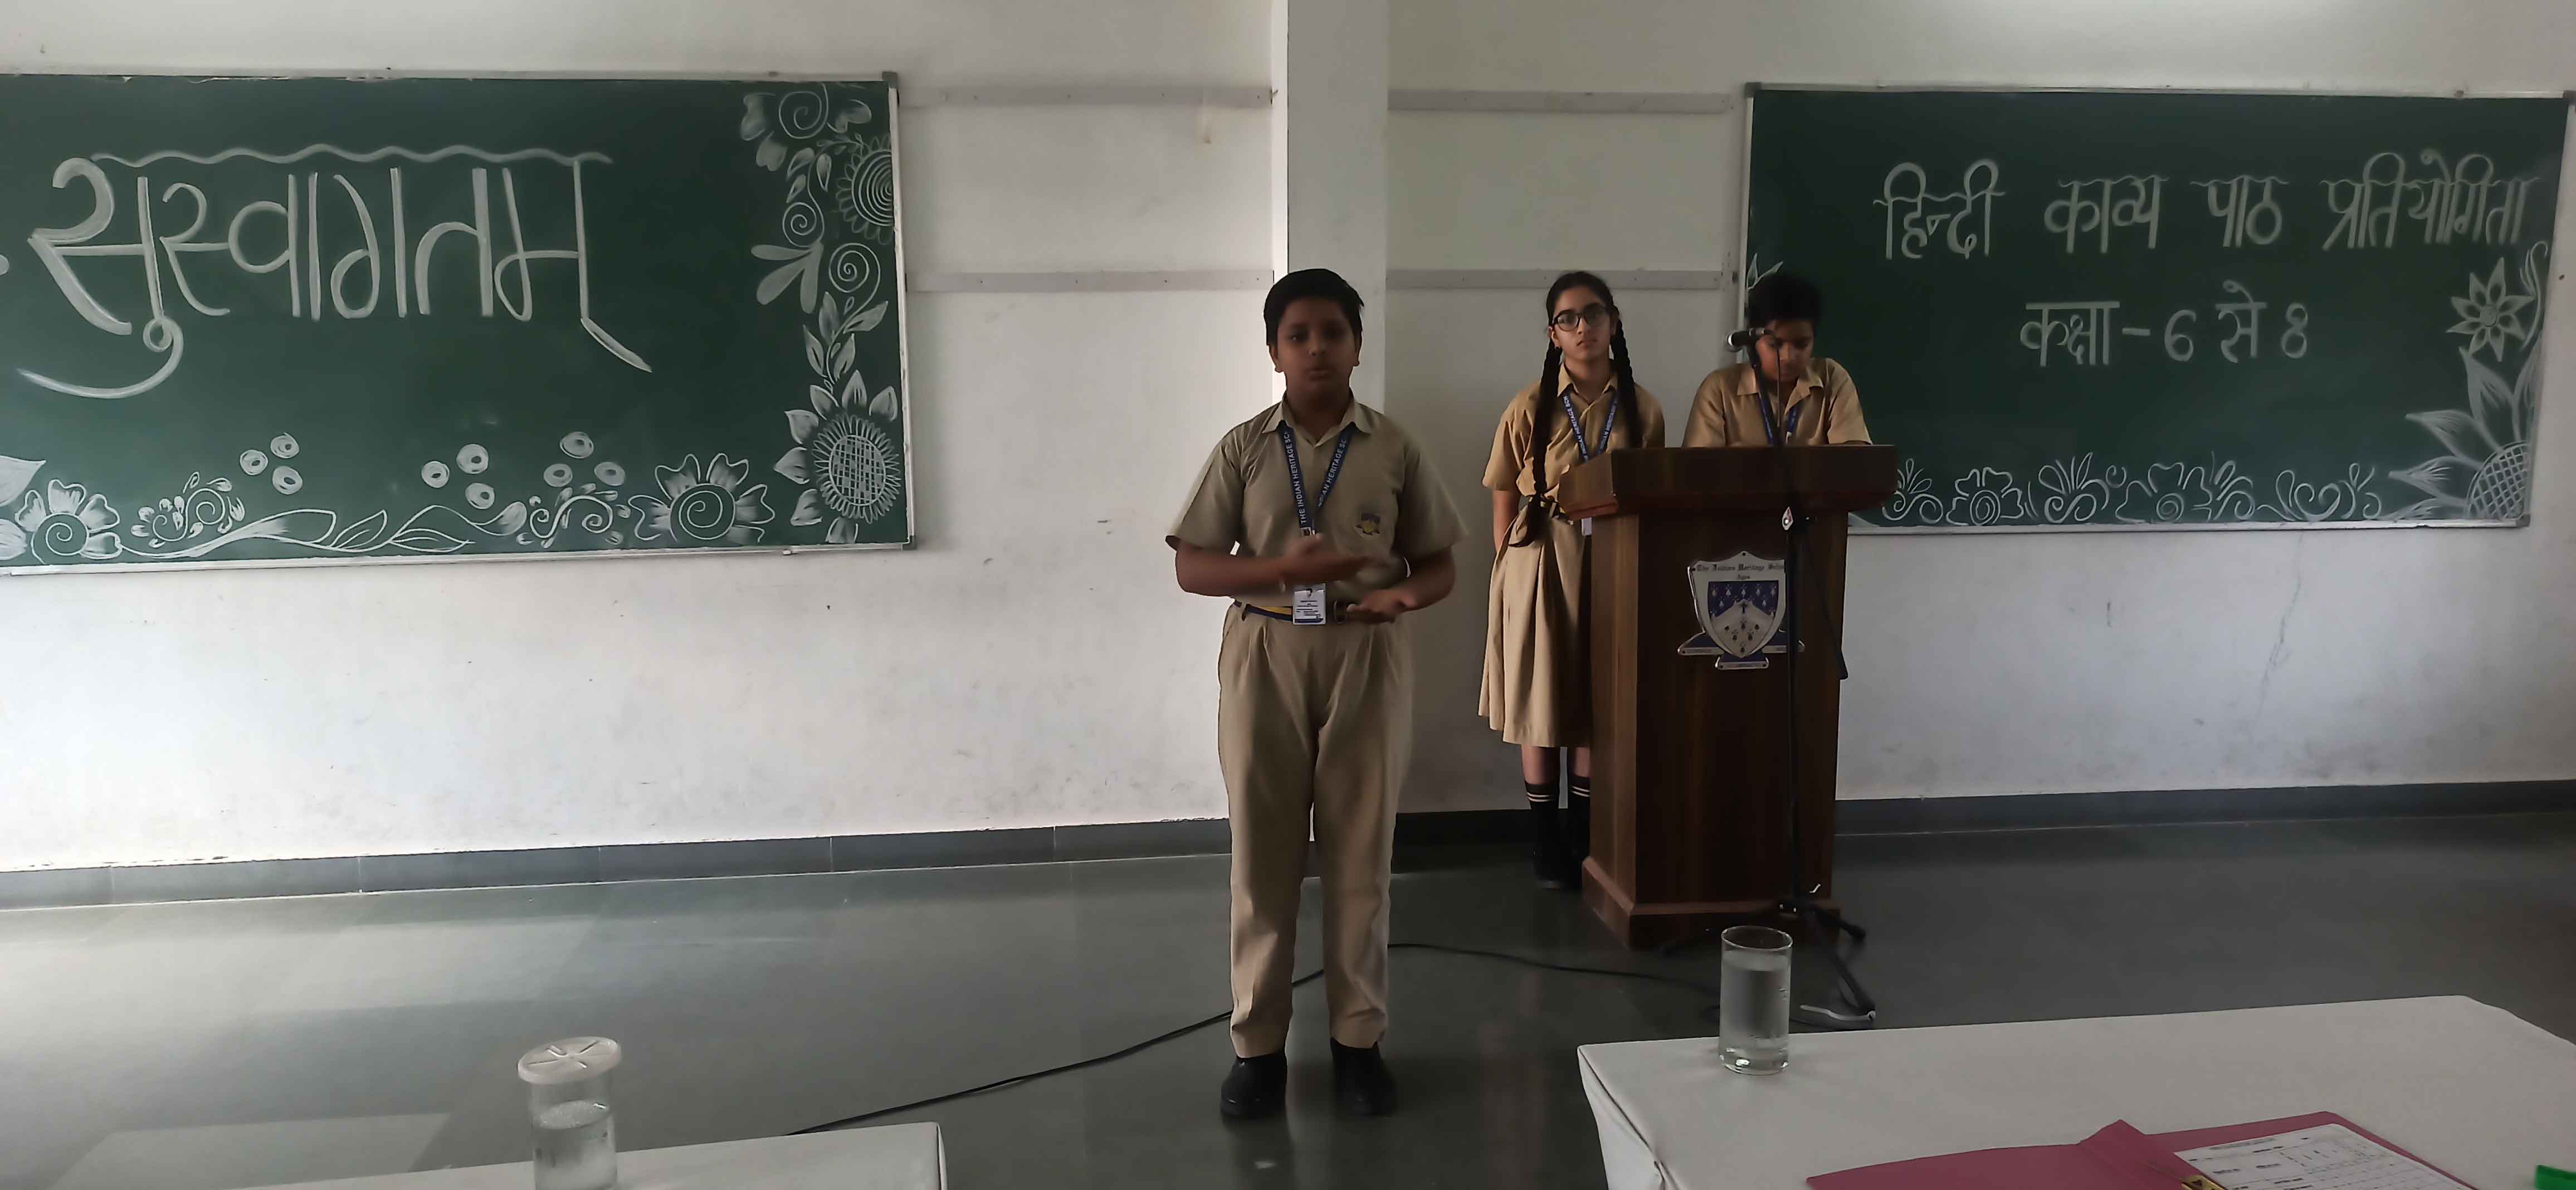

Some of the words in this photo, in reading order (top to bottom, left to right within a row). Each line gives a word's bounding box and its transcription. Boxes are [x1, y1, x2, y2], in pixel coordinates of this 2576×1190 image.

[1872, 158, 2006, 260] हिन्दी
[2043, 174, 2169, 255] काव्य
[2189, 174, 2289, 248] पाठ
[2318, 148, 2541, 252] प्रतियोगिता
[16, 143, 653, 399] सुस्वागतम्
[2215, 280, 2267, 364] से
[2281, 303, 2308, 359] 8
[1286, 444, 1299, 480] HERITAGE
[1294, 481, 1305, 507] INDIAN
[1299, 508, 1307, 524] THE
